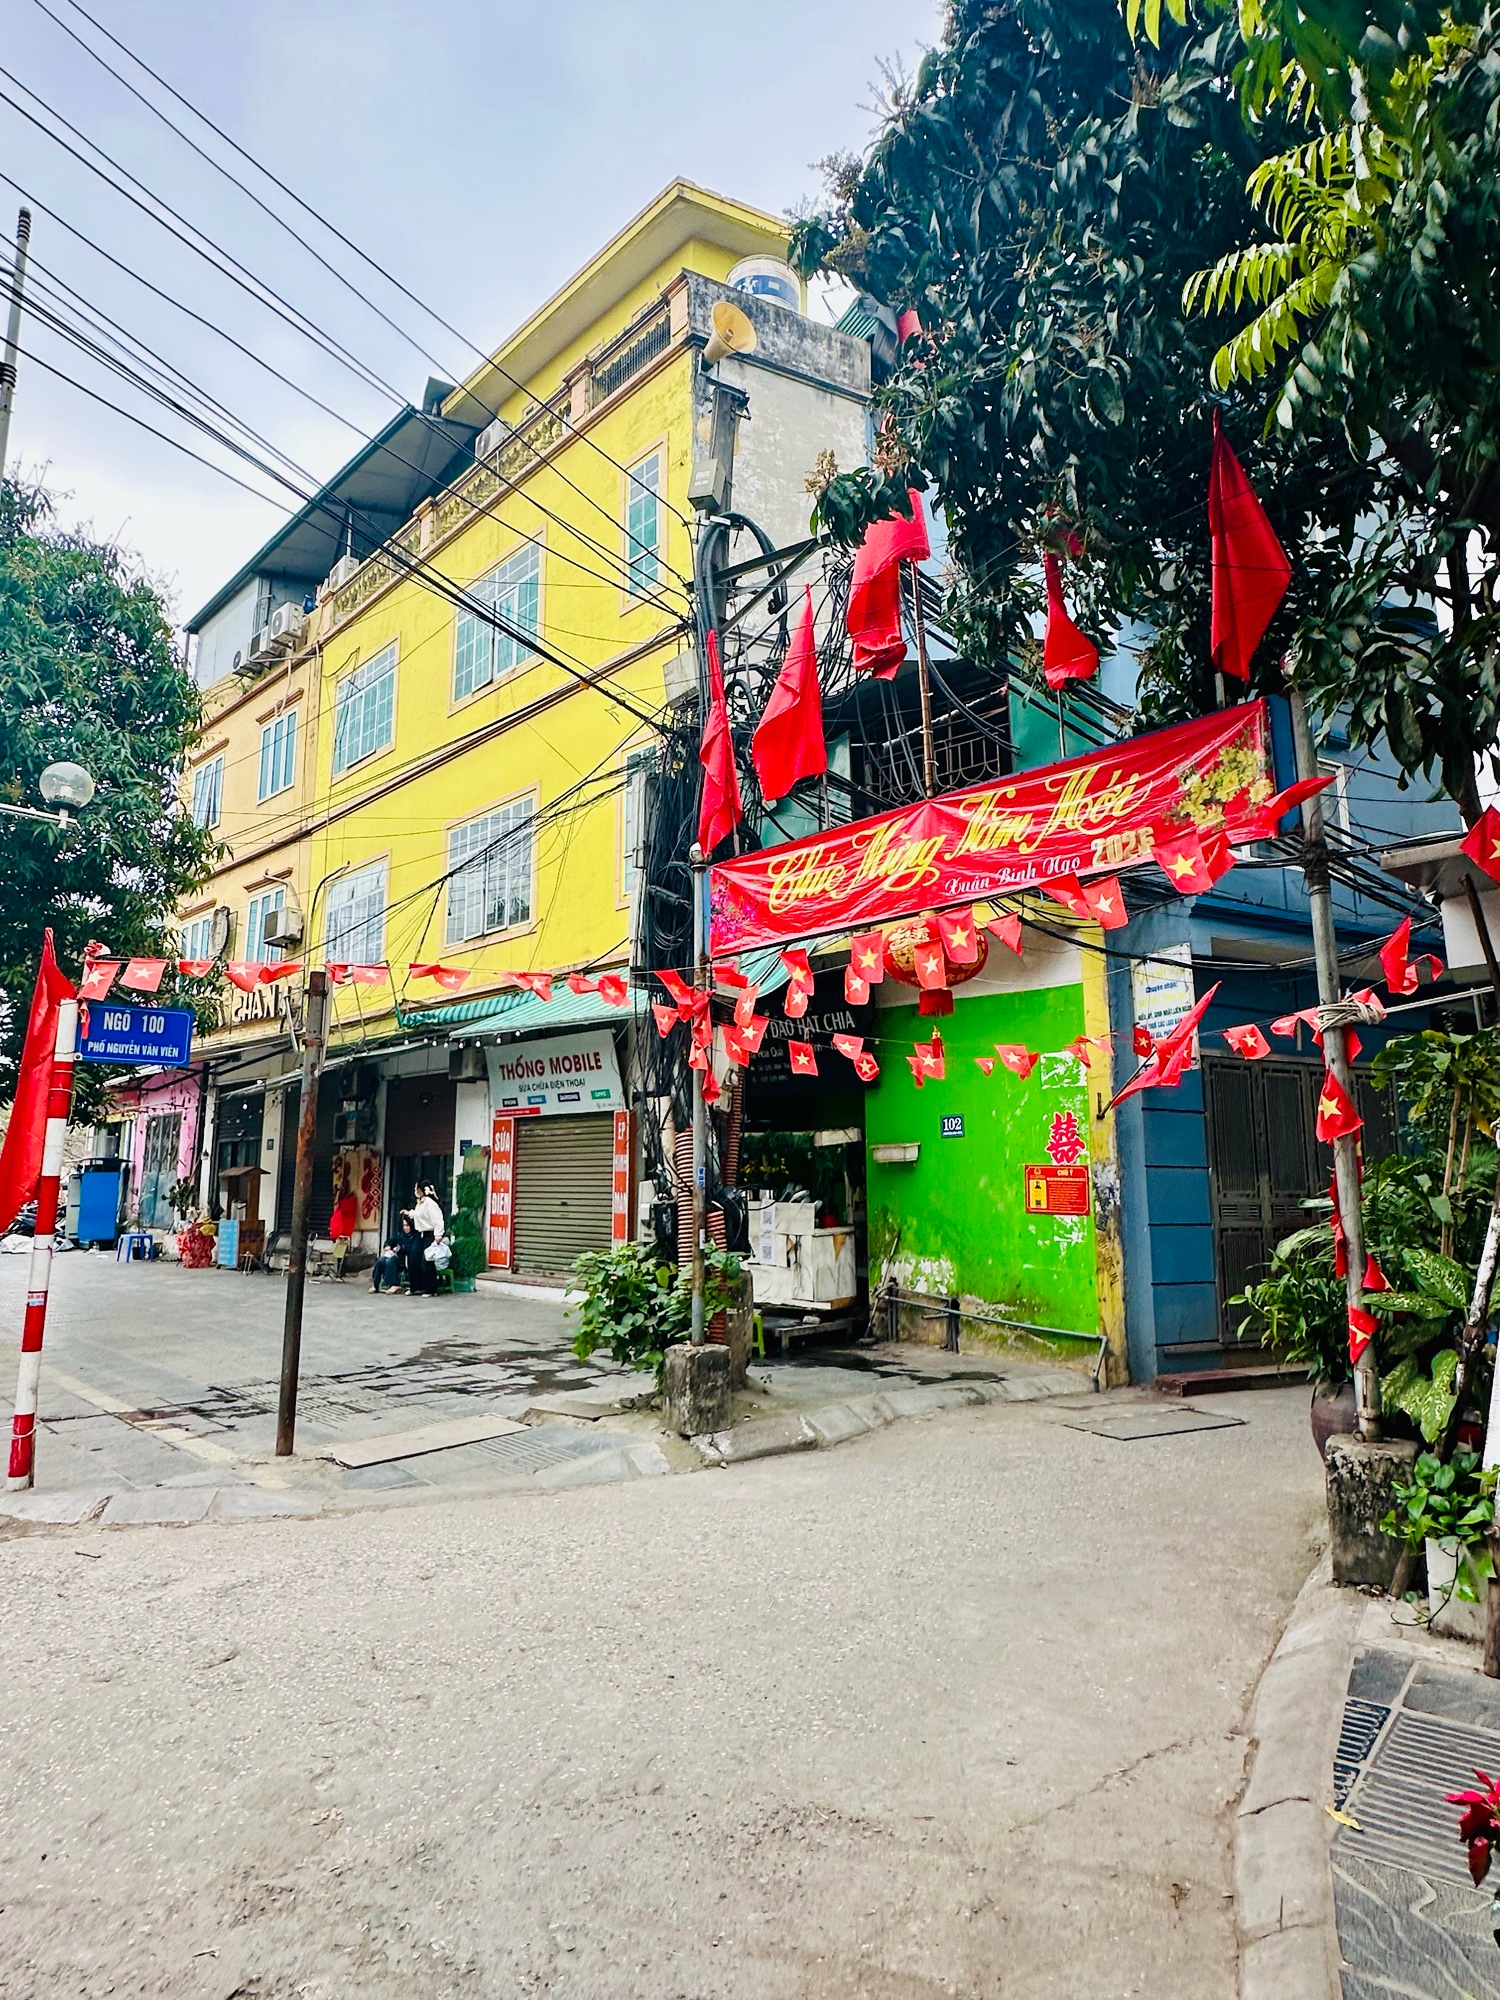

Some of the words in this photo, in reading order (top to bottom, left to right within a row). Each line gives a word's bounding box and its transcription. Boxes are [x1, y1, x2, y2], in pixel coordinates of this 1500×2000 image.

[767, 842, 847, 914] Chúc
[830, 817, 948, 900] Mừng
[944, 786, 1035, 861] Năm
[1019, 764, 1153, 855] Mới
[1090, 827, 1156, 867] 2026
[103, 1010, 131, 1032] NGÕ
[142, 1015, 165, 1034] 100
[823, 1010, 856, 1032] CHIA
[87, 1039, 107, 1053] PHỐ
[106, 1039, 141, 1056] NGUYỄN
[142, 1042, 159, 1057] VĂN
[160, 1044, 180, 1058] VIÊN
[499, 1054, 546, 1081] THỐNG
[548, 1051, 603, 1076] MOBILE
[942, 1117, 962, 1131] 102
